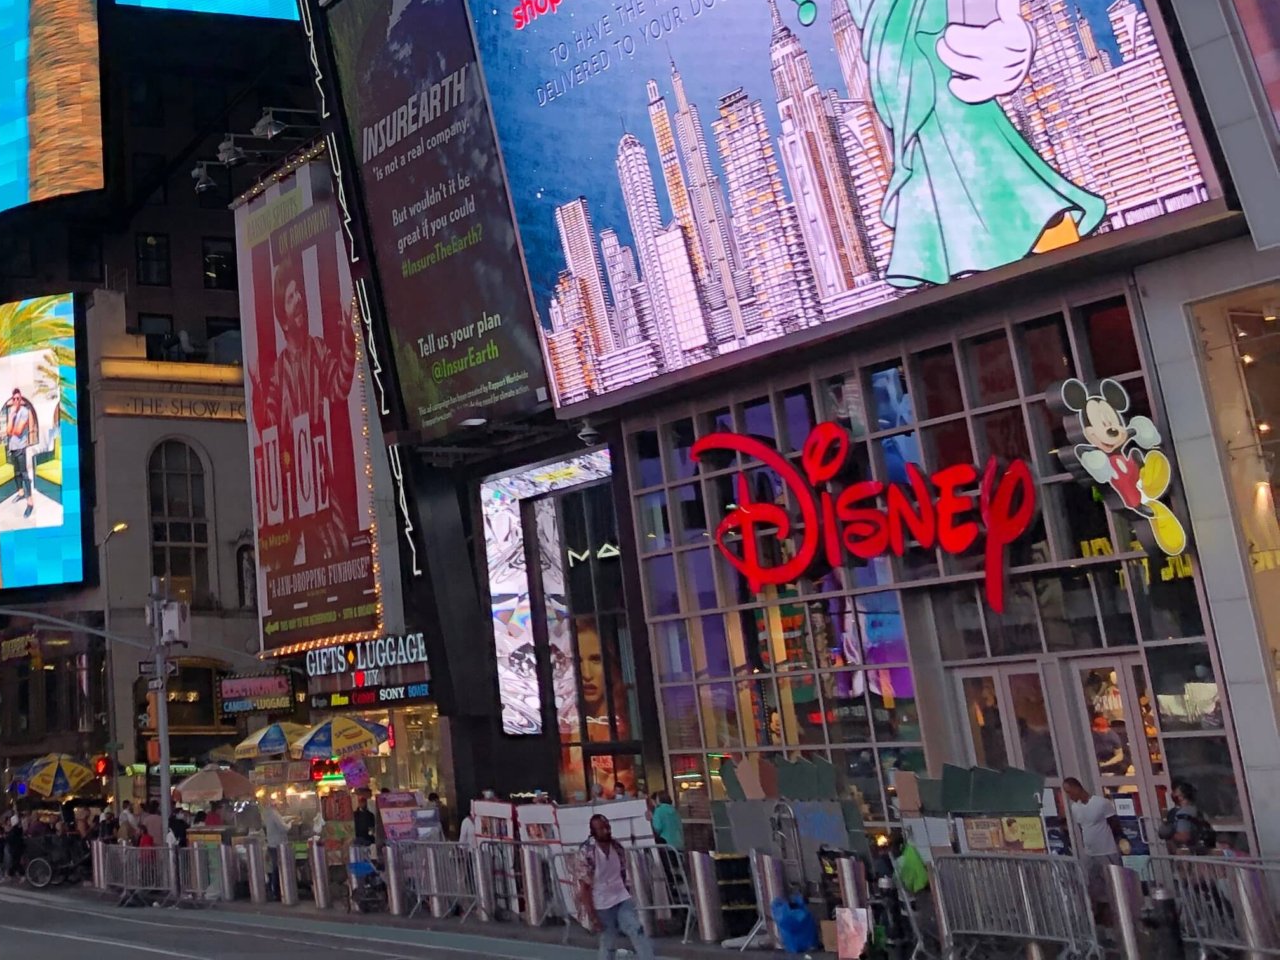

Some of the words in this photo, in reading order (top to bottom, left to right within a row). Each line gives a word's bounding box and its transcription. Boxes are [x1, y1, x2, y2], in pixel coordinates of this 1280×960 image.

[537, 49, 611, 107] DELIVERED
[614, 35, 636, 58] TO
[639, 8, 685, 46] YOUR
[549, 41, 570, 67] TO
[575, 15, 612, 53] HAVE
[385, 157, 399, 176] not
[400, 155, 406, 166] a
[407, 137, 424, 162] real
[426, 118, 470, 150] company.
[391, 206, 408, 227] But
[408, 182, 447, 218] wouldn't
[448, 179, 456, 196] it
[457, 172, 471, 191] be
[397, 225, 421, 255] great
[421, 218, 429, 240] if
[430, 215, 448, 237] you
[449, 194, 476, 223] could
[418, 333, 436, 358] Tell
[437, 334, 449, 350] us
[450, 323, 475, 349] your
[477, 311, 502, 338] plan
[431, 339, 500, 383] @InsurEarth
[131, 398, 163, 414] THE
[171, 399, 221, 416] SHOW
[277, 568, 327, 597] JAW-DROPPING
[306, 645, 346, 677] GIFTS
[356, 633, 428, 670] LUGGAGE
[256, 696, 290, 711] LUGGAGE
[379, 687, 405, 701] SONY
